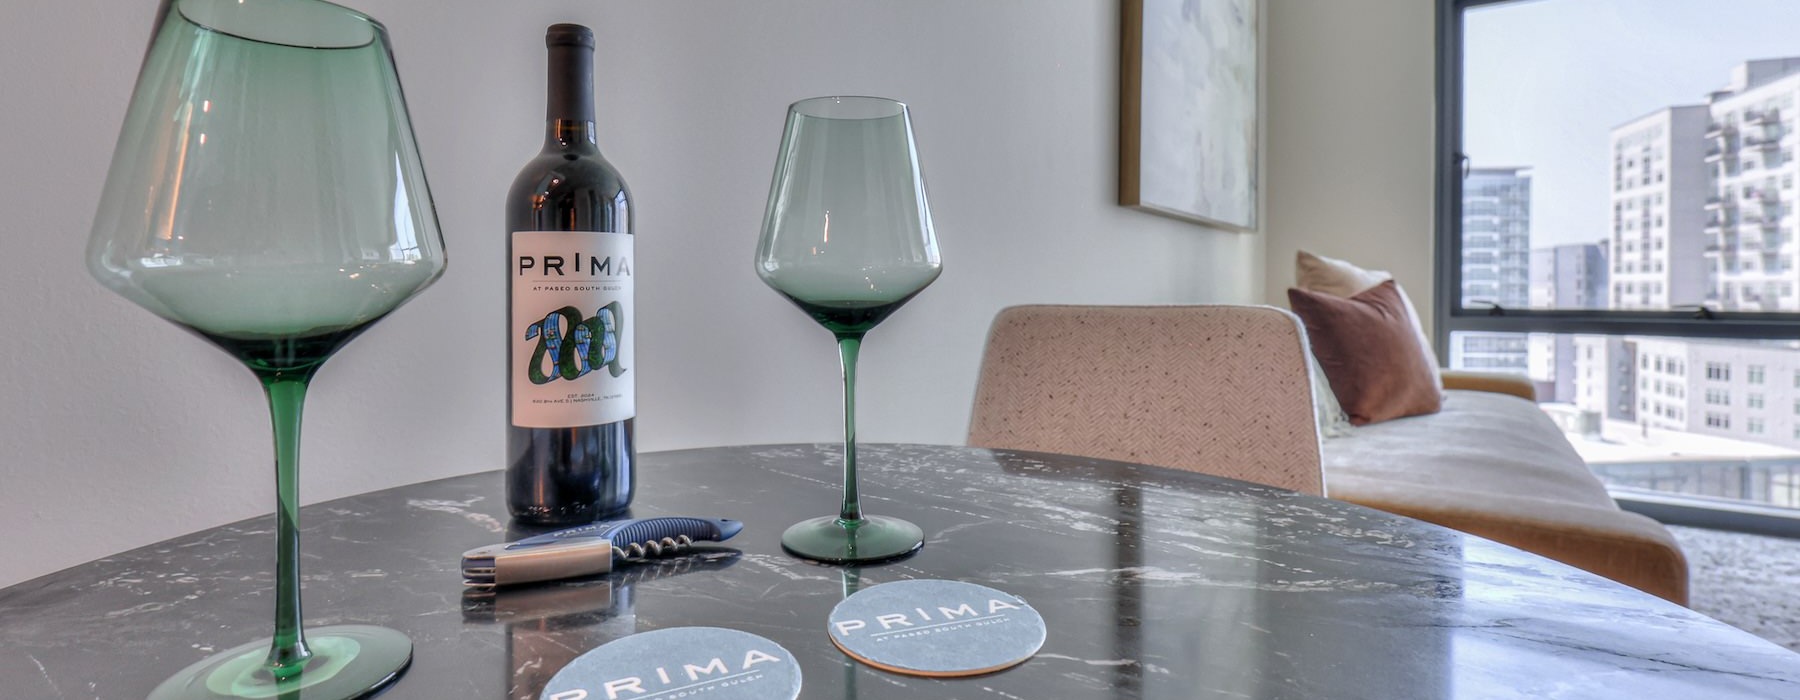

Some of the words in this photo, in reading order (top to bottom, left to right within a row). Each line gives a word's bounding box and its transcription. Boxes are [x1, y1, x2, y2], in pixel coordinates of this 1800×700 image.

[519, 252, 631, 277] PRIMA
[836, 599, 1021, 636] PRIMA
[935, 623, 971, 633] SOUTH
[975, 617, 1010, 626] GULCH
[669, 685, 715, 700] SOUTH
[721, 674, 763, 687] GULCH
